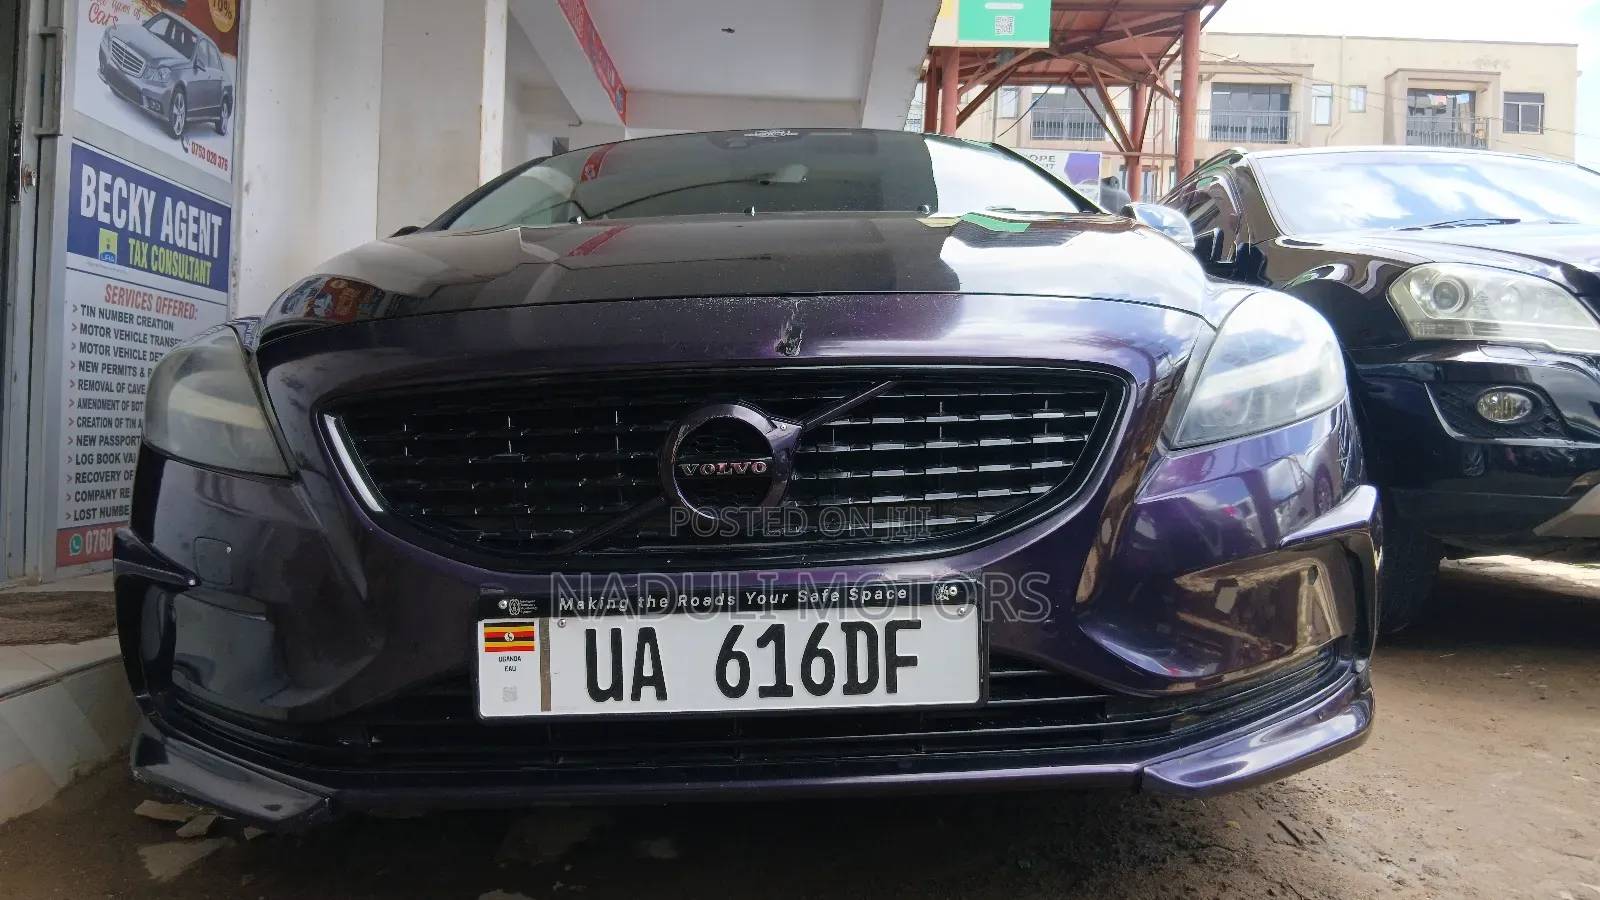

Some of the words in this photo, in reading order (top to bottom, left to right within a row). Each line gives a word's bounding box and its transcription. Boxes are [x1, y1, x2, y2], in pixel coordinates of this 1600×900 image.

[88, 3, 119, 29] Cars
[81, 163, 157, 237] BECKY
[160, 196, 223, 259] AGENT
[128, 238, 149, 269] TAX
[151, 245, 212, 286] CONSULTANT
[104, 284, 153, 312] SERVICES
[155, 296, 199, 320] OFFERED:
[81, 304, 96, 318] TIN
[98, 307, 135, 325] NUMBER
[136, 316, 174, 332] CREATION
[80, 323, 111, 338] MOTOR
[113, 328, 148, 345] VEHICLE
[79, 342, 111, 357] MOTOR
[113, 346, 148, 362] VEHICLE
[78, 360, 99, 374] NEW
[101, 362, 138, 378] PERMITS
[139, 367, 146, 378] &
[78, 379, 114, 393] REMOVAL
[116, 382, 126, 394] OF
[127, 383, 146, 395] CAVE
[77, 398, 120, 411] AMENDMENT
[121, 400, 130, 411] OF
[131, 401, 144, 412] BOT
[76, 416, 113, 429] CREATION
[114, 417, 124, 429] OF
[125, 418, 137, 429] TIN
[76, 435, 97, 447] NEW
[75, 453, 94, 466] LOG
[96, 453, 121, 465] BOOK
[74, 470, 122, 484] RECOVERY
[123, 470, 134, 481] OF
[678, 461, 768, 476] VOLVO
[74, 488, 118, 503] COMPANY
[119, 487, 131, 499] RE
[73, 507, 98, 522] LOST
[99, 505, 130, 517] NUMBE
[559, 597, 629, 612] Making
[638, 595, 668, 608] the
[678, 593, 736, 608] Roads
[745, 592, 789, 605] Your
[797, 588, 840, 603] Safe
[849, 588, 907, 604] Space
[498, 655, 522, 663] UGANDA
[585, 626, 668, 702] UA
[715, 619, 922, 699] 616DF
